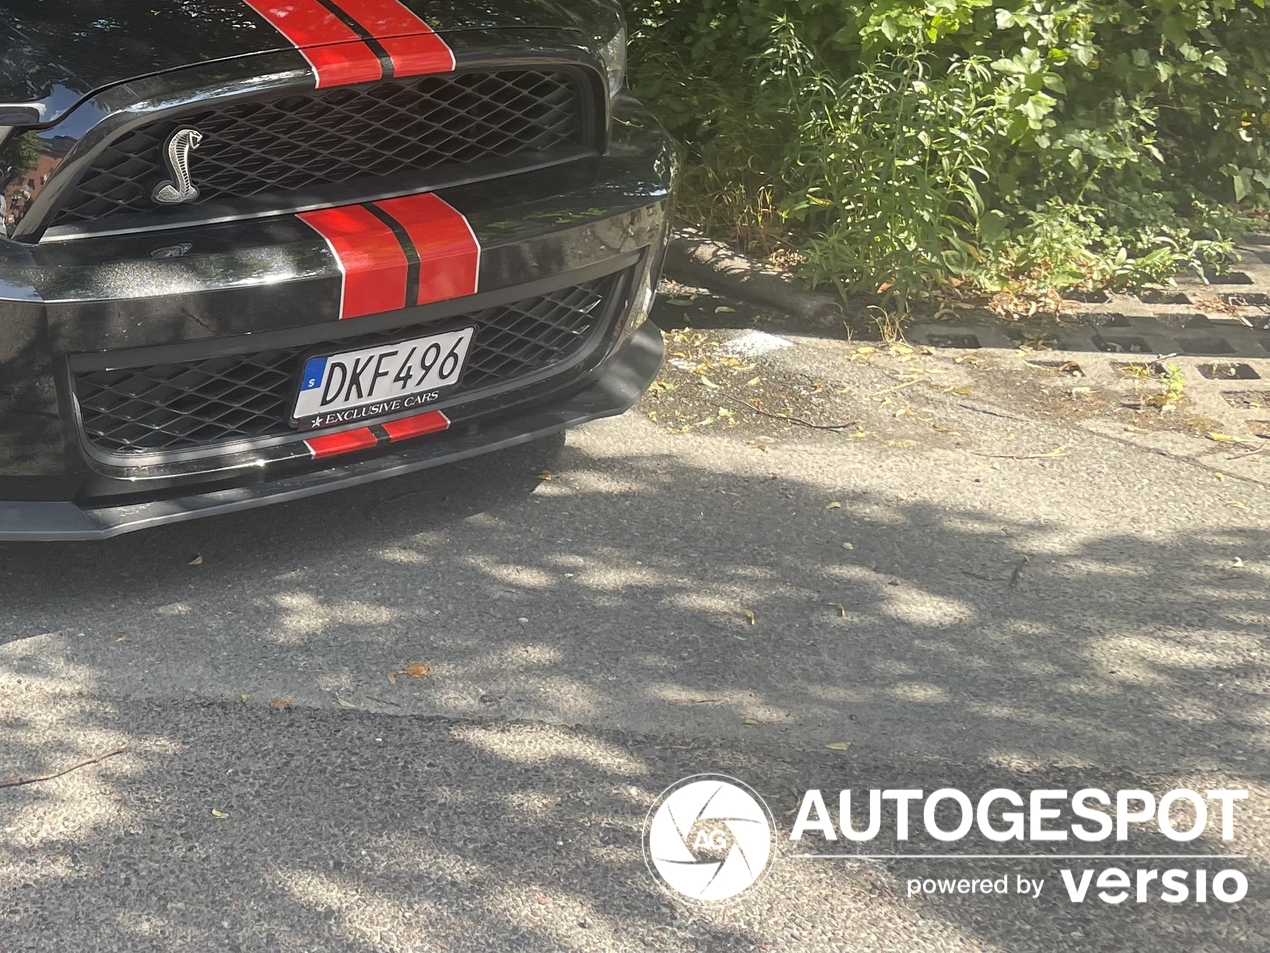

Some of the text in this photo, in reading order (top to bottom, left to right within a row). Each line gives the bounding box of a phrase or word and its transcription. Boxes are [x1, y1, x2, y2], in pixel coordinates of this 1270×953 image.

[308, 378, 316, 388] S
[320, 336, 465, 407] DKF496
[325, 390, 440, 424] EXCLUSIVE CARS
